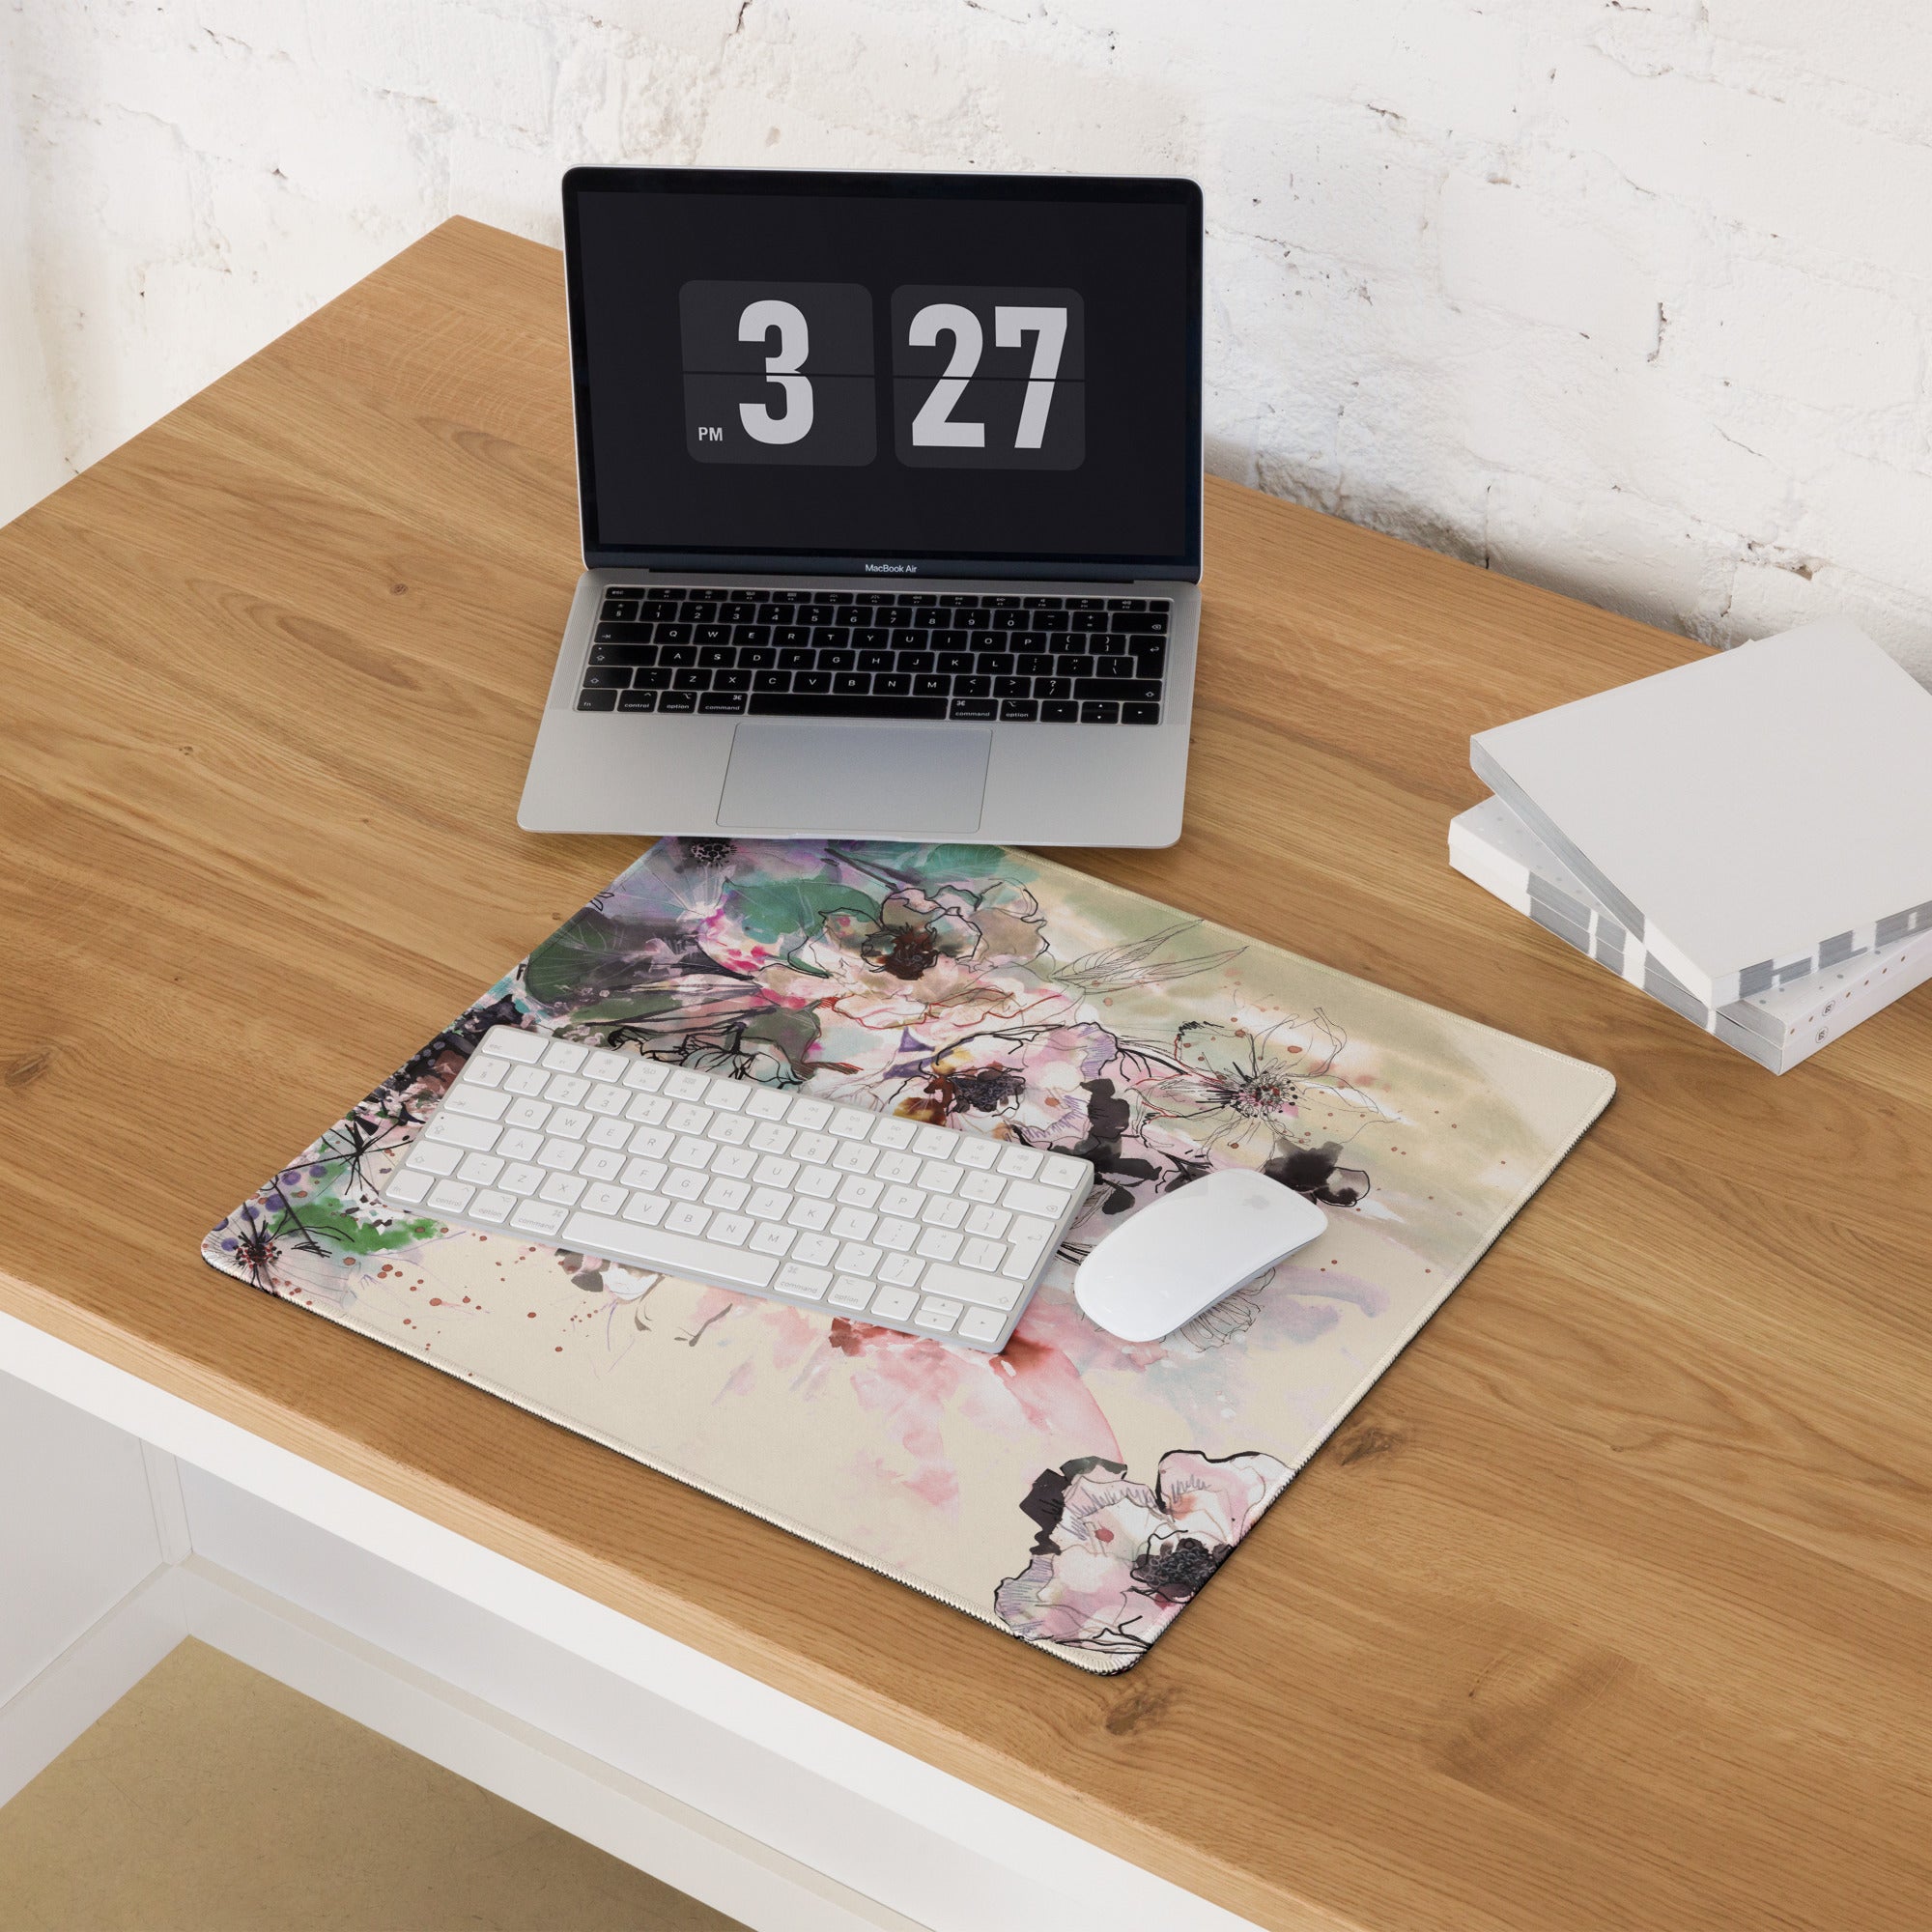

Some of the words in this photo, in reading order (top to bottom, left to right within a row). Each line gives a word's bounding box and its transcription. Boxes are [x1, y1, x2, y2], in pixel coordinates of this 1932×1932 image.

[738, 299, 813, 444] 3
[909, 303, 1067, 448] 27
[698, 427, 723, 441] PM
[865, 563, 904, 573] MacBook
[905, 564, 918, 573] Air
[787, 632, 796, 640] R
[827, 633, 835, 641] T
[983, 637, 994, 645] O
[1023, 638, 1033, 646] P
[768, 676, 778, 685] C
[524, 1108, 535, 1119] Q
[564, 1118, 578, 1127] W
[605, 1127, 616, 1137] E
[646, 1137, 657, 1147] R
[690, 1147, 699, 1156] T
[731, 1156, 741, 1166] Y
[771, 1166, 782, 1177] U
[855, 1186, 867, 1197] O
[897, 1196, 908, 1205] P
[516, 1174, 528, 1183] Z
[557, 1182, 569, 1193] X
[599, 1193, 611, 1203] C
[642, 1204, 653, 1213] V
[683, 1213, 694, 1223] B
[725, 1224, 737, 1234] N
[767, 1233, 781, 1243] M
[596, 1158, 609, 1169] D
[639, 1169, 649, 1178] F
[680, 1179, 692, 1189] G
[722, 1188, 734, 1199] H
[807, 1208, 817, 1218] K
[436, 1197, 463, 1208] control
[478, 1208, 502, 1217] option
[518, 1216, 556, 1230] command
[780, 1281, 818, 1294] command
[834, 1293, 859, 1304] option
